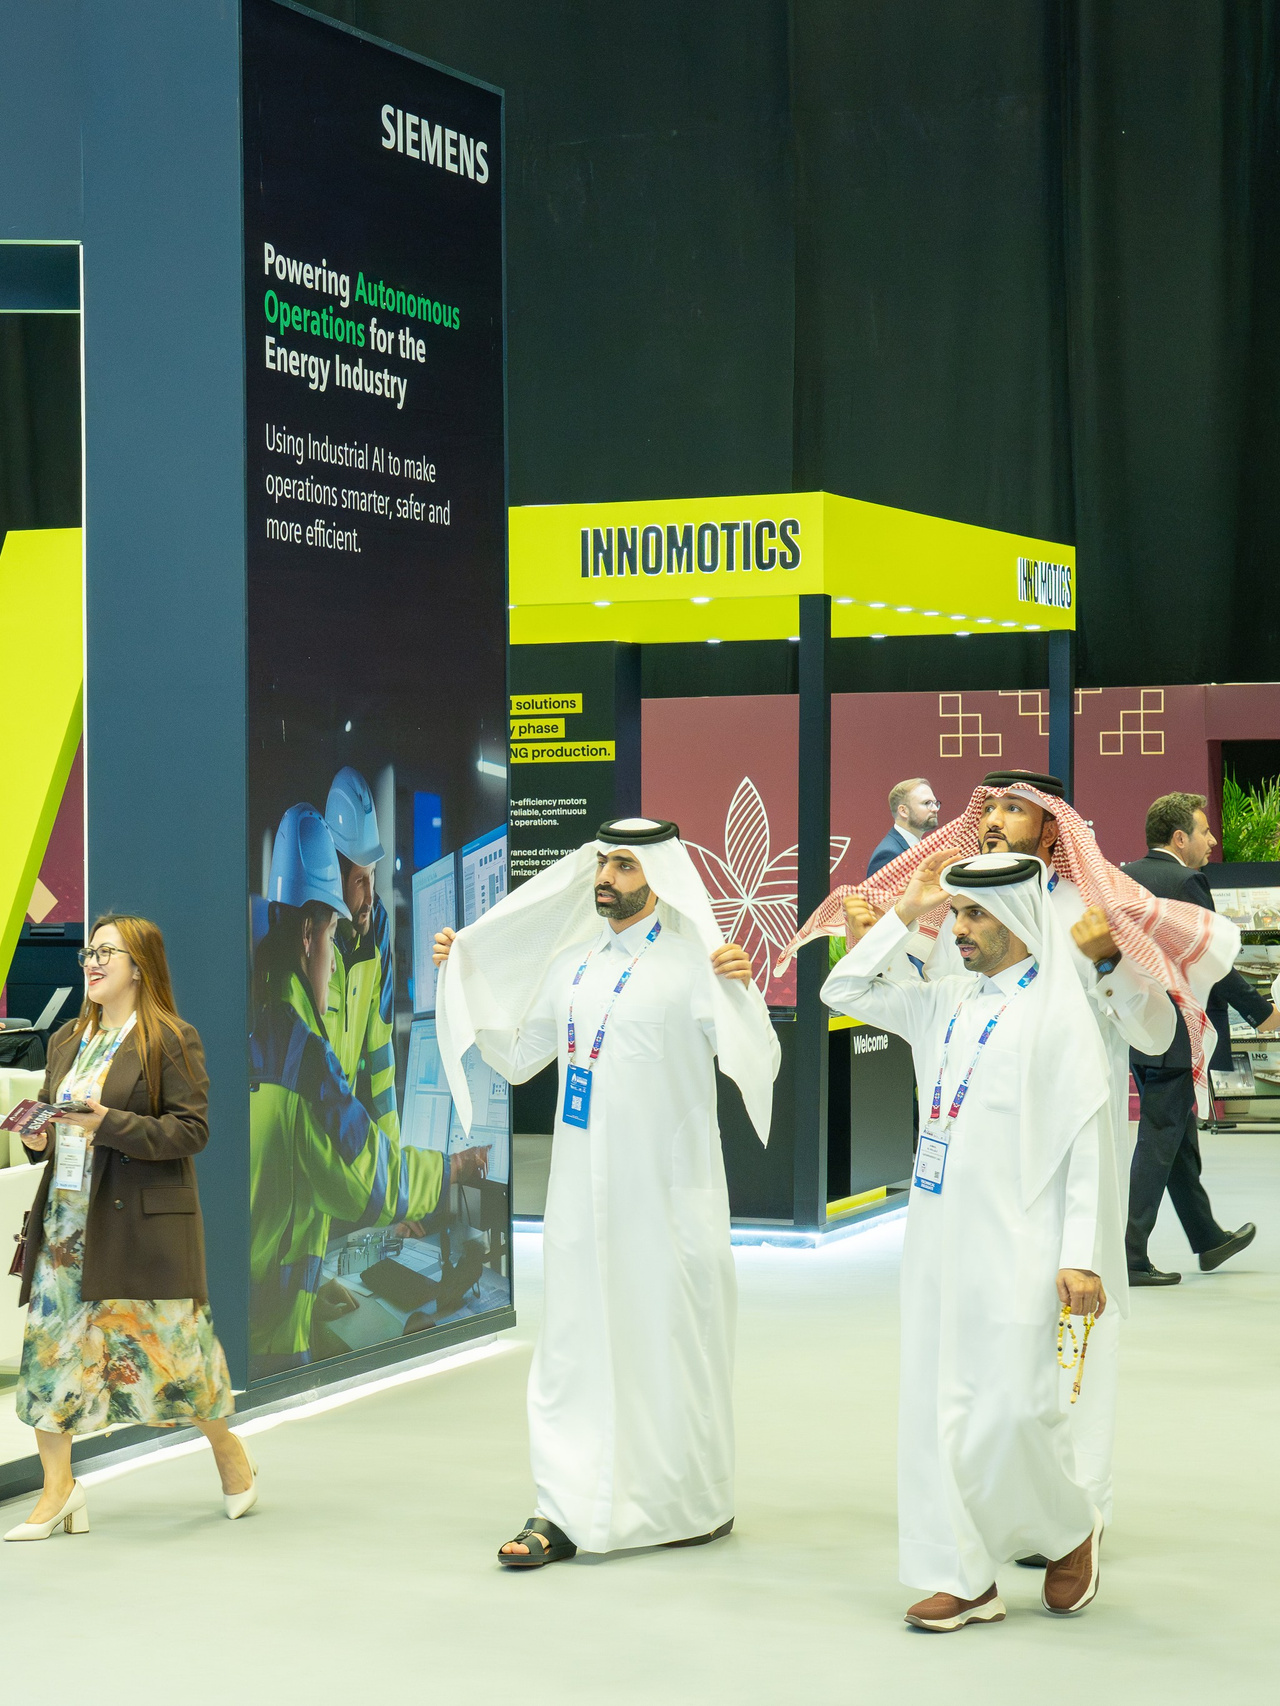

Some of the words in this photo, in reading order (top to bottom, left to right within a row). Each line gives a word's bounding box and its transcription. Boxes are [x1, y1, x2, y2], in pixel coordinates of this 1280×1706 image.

[381, 104, 489, 184] SIEMENS
[264, 242, 350, 308] Powering
[355, 271, 460, 330] Autonomous
[264, 289, 365, 347] Operations
[370, 317, 394, 354] for
[398, 327, 426, 363] the
[265, 335, 330, 392] Energy
[335, 354, 407, 410] Industry
[266, 423, 304, 465] Using
[308, 433, 368, 470] Industrial
[372, 446, 384, 473] AI
[388, 451, 401, 476] to
[404, 455, 436, 483] make
[266, 473, 338, 507] operations
[341, 488, 392, 520] smarter,
[396, 493, 425, 521] safer
[428, 500, 451, 526] and
[266, 517, 302, 544] more
[305, 519, 362, 553] efficient.
[580, 518, 800, 578] INNOMOTICS
[1018, 556, 1072, 610] INNOMOTICS
[516, 698, 576, 710] solutions
[518, 722, 559, 737] phase
[532, 744, 610, 760] production.
[510, 798, 557, 806] h-efficiency
[510, 808, 541, 816] reliable,
[542, 808, 587, 816] continuous
[514, 818, 559, 827] operations.
[511, 858, 540, 867] precise
[539, 848, 559, 856] drive
[853, 1033, 888, 1055] Welcome
